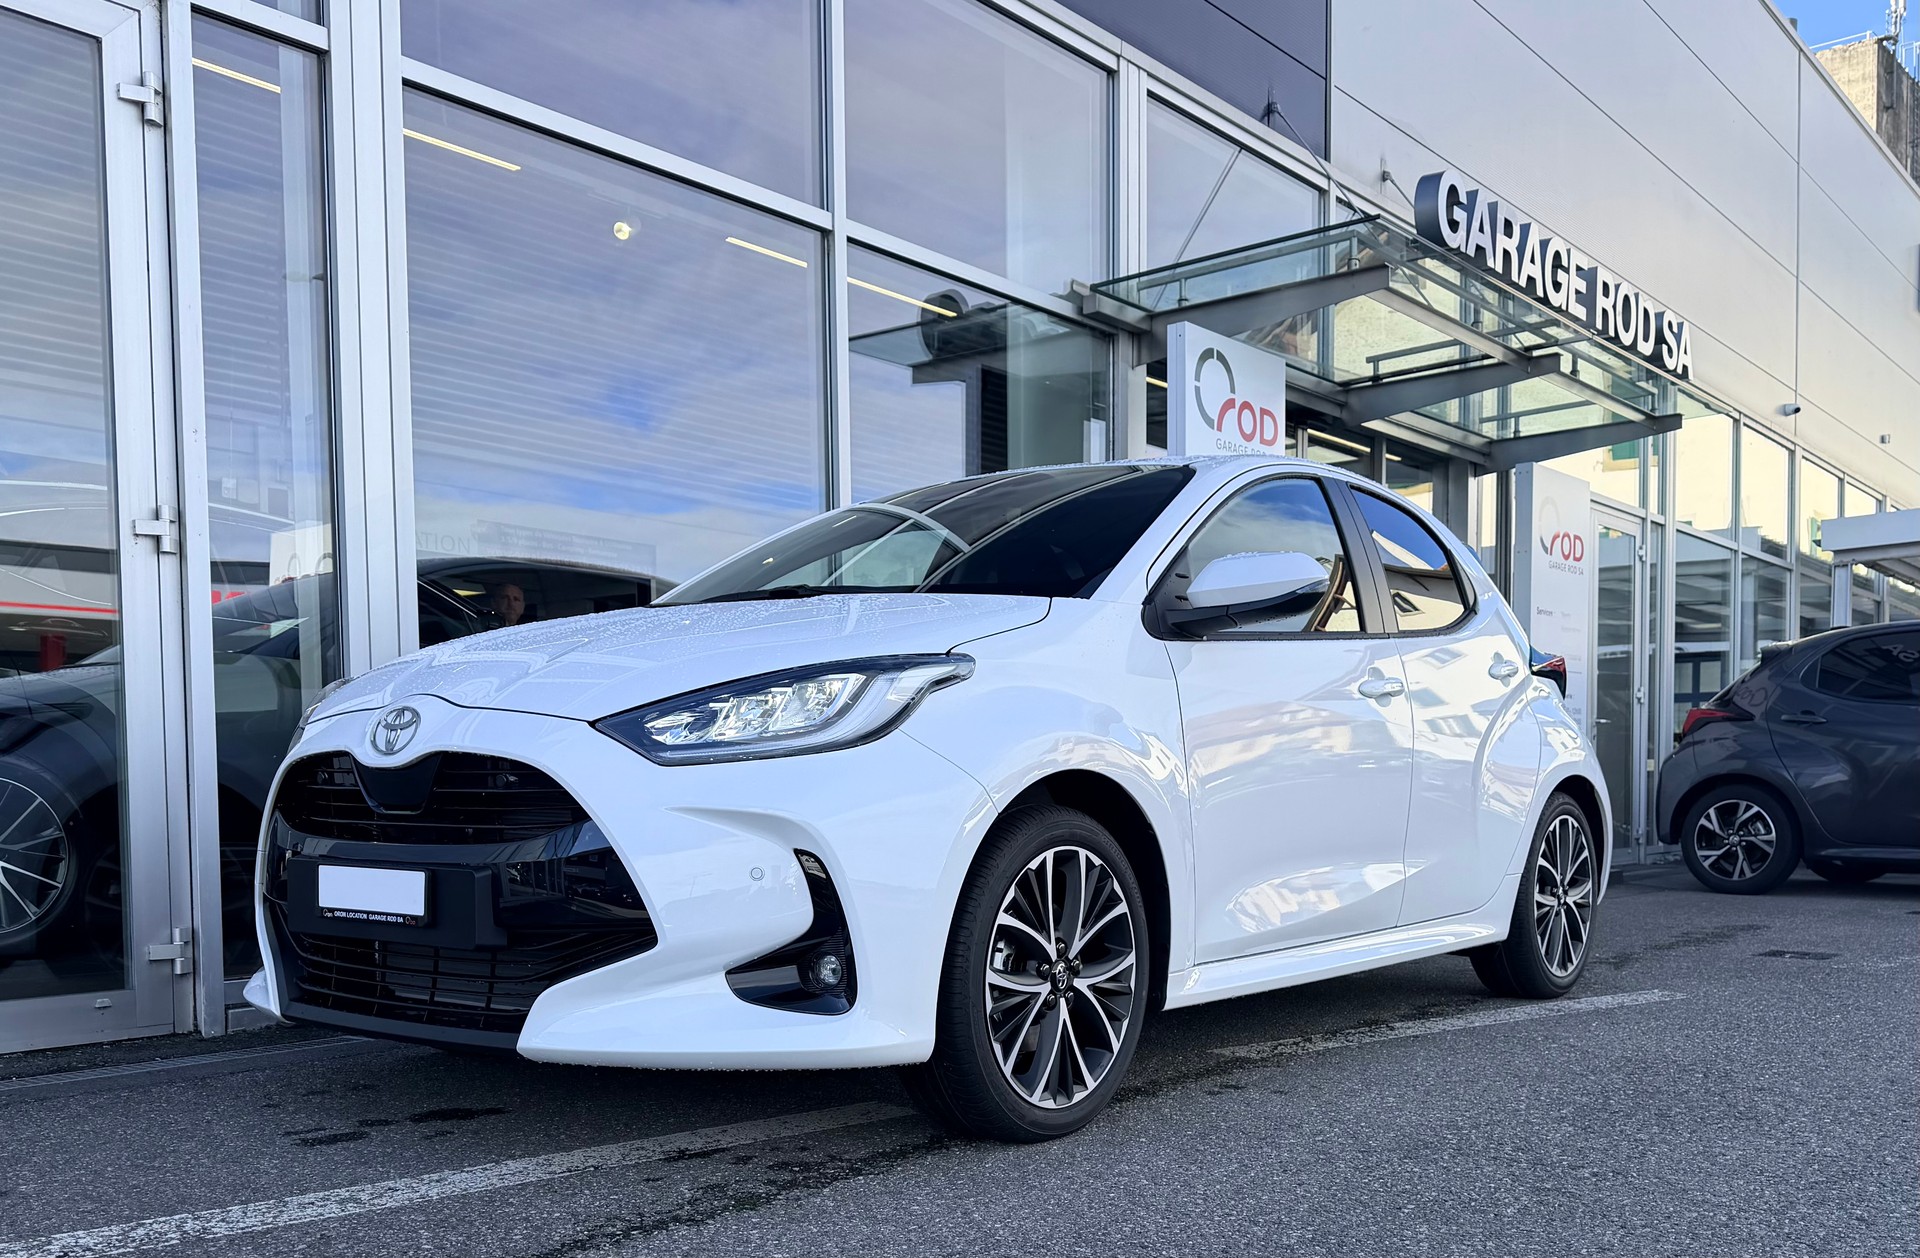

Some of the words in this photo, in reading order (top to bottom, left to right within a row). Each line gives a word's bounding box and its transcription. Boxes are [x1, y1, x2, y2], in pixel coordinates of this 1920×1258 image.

[1436, 168, 1589, 321] GARAGE
[1595, 265, 1656, 356] ROD
[1661, 309, 1694, 381] SA
[1216, 438, 1249, 455] GARAGE
[1548, 560, 1567, 573] GARAGE
[346, 912, 368, 920] LOCATION
[368, 914, 387, 922] GARAGE
